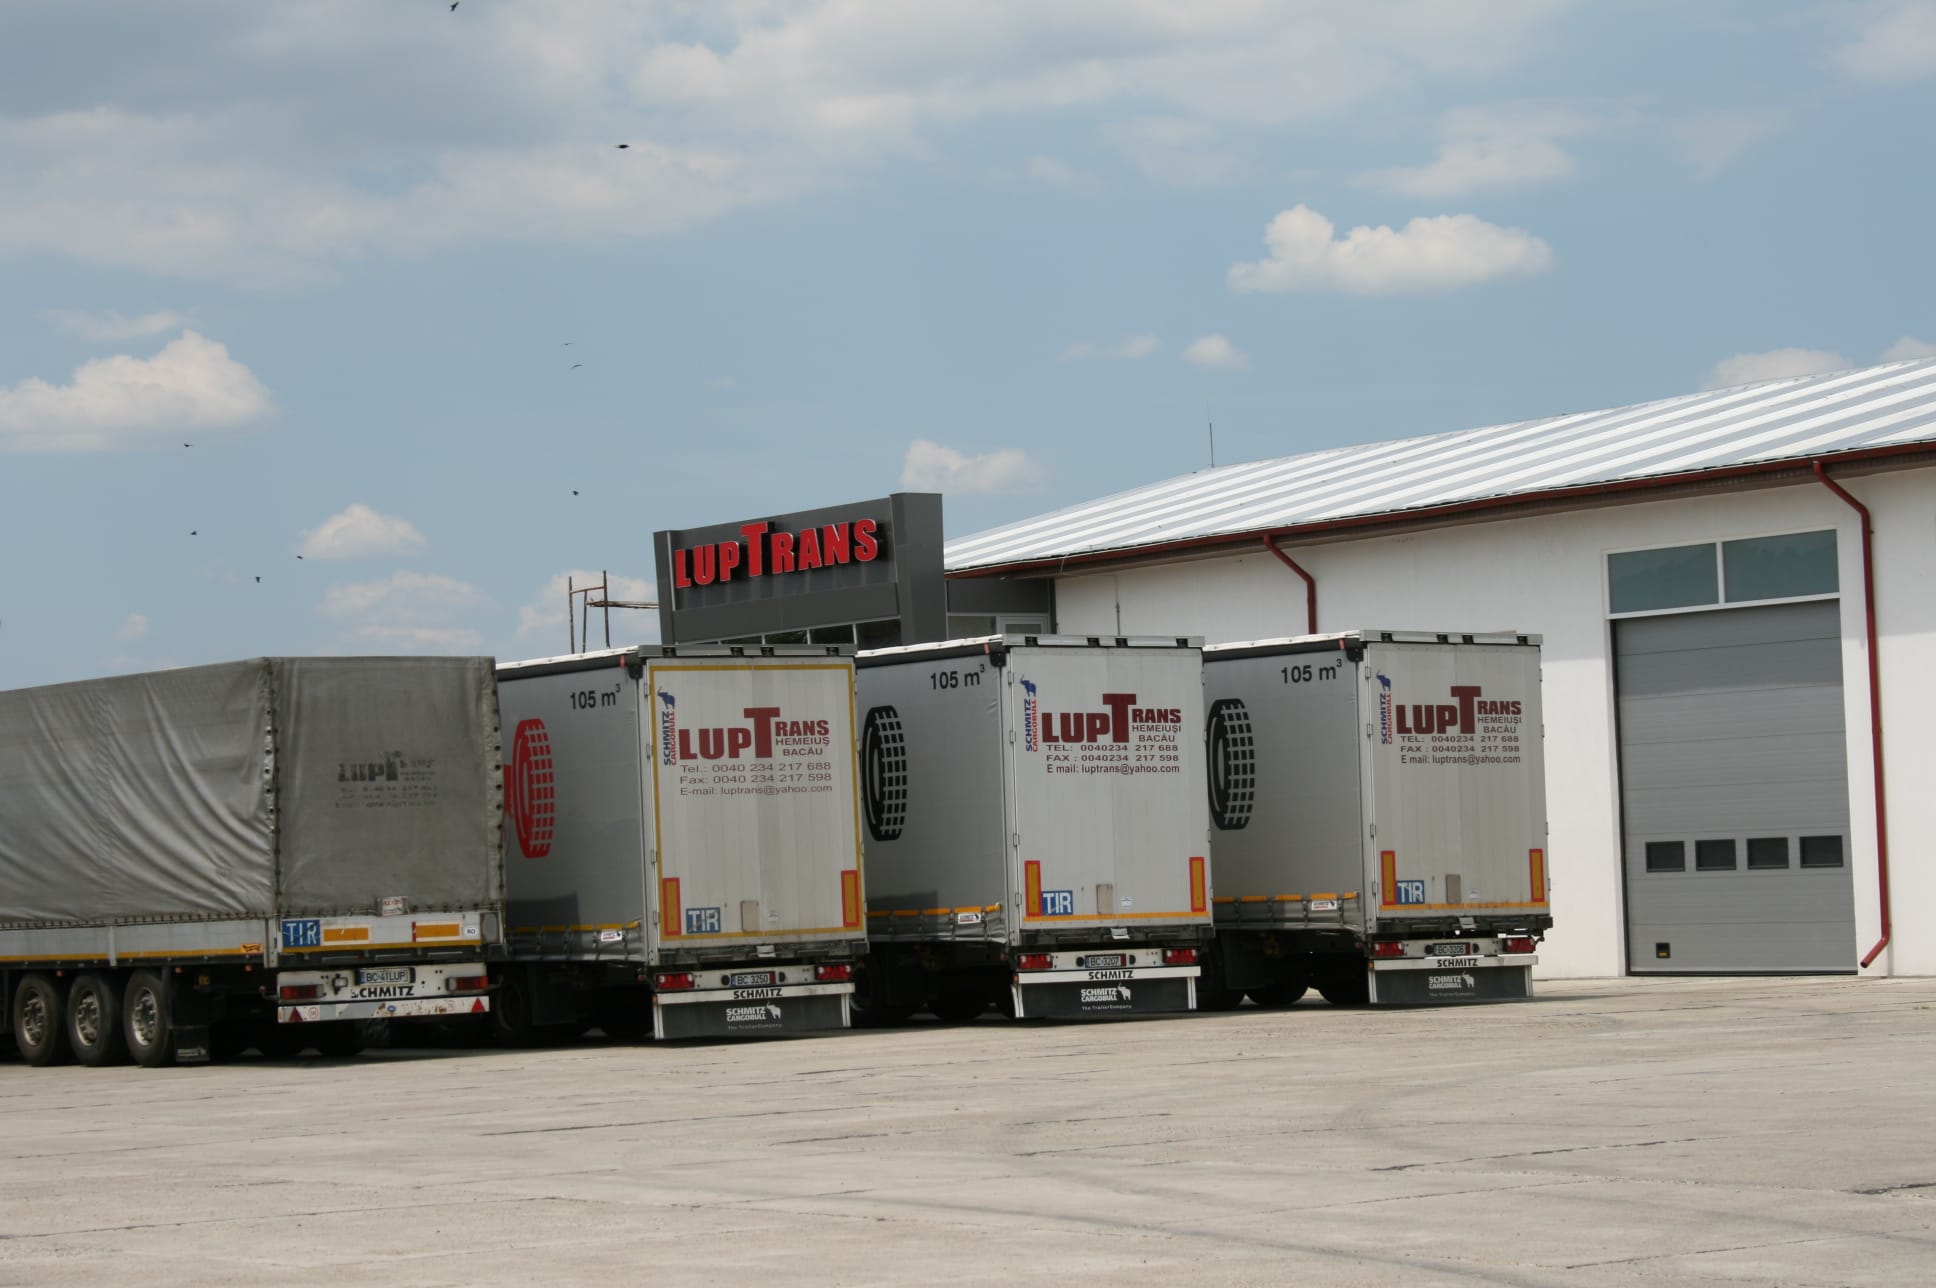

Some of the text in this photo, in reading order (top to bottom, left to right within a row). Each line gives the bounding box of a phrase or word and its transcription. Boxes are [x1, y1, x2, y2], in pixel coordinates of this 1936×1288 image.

[1281, 664, 1312, 684] 105
[930, 671, 958, 690] 105
[570, 690, 596, 710] 105
[1024, 698, 1033, 752] SCHMITZ
[1031, 698, 1039, 752] CARGOBULL
[662, 711, 671, 765] SCHMITZ
[1431, 735, 1474, 743] 0040234
[1480, 735, 1498, 743] 217
[1501, 735, 1519, 743] 688
[1080, 744, 1128, 752] 0040234
[1135, 744, 1154, 752] 217
[1158, 744, 1178, 752] 688
[1400, 745, 1422, 753] FAX
[1432, 745, 1475, 753] 0040234
[1480, 745, 1498, 753] 217
[1502, 745, 1520, 753] 598
[1081, 754, 1129, 762] 0040234
[1135, 754, 1155, 762] 217
[1159, 754, 1179, 762] 598
[1432, 754, 1521, 766] luptrans@yahoo.com
[712, 763, 746, 773] 0040
[750, 762, 773, 772] 234
[779, 762, 803, 771] 217
[807, 761, 831, 771] 688
[1081, 763, 1180, 775] luptrans@yahoo.com
[713, 774, 747, 784] 0040
[751, 773, 775, 783] 234
[779, 773, 804, 783] 217
[808, 772, 832, 782] 598
[720, 784, 833, 796] luptrans@yahoo.com
[1397, 882, 1424, 903] TIR
[1042, 892, 1072, 914] TIR
[687, 909, 720, 931] TIR
[286, 922, 318, 945] TIR
[1437, 958, 1478, 967] SCHMITZ
[1088, 970, 1134, 980] SCHMITZ
[1429, 975, 1462, 983] SCHMITZ
[733, 987, 783, 999] SCHMITZ
[1080, 987, 1118, 996] SCHMITZ
[726, 1006, 766, 1016] SCHMITZ
